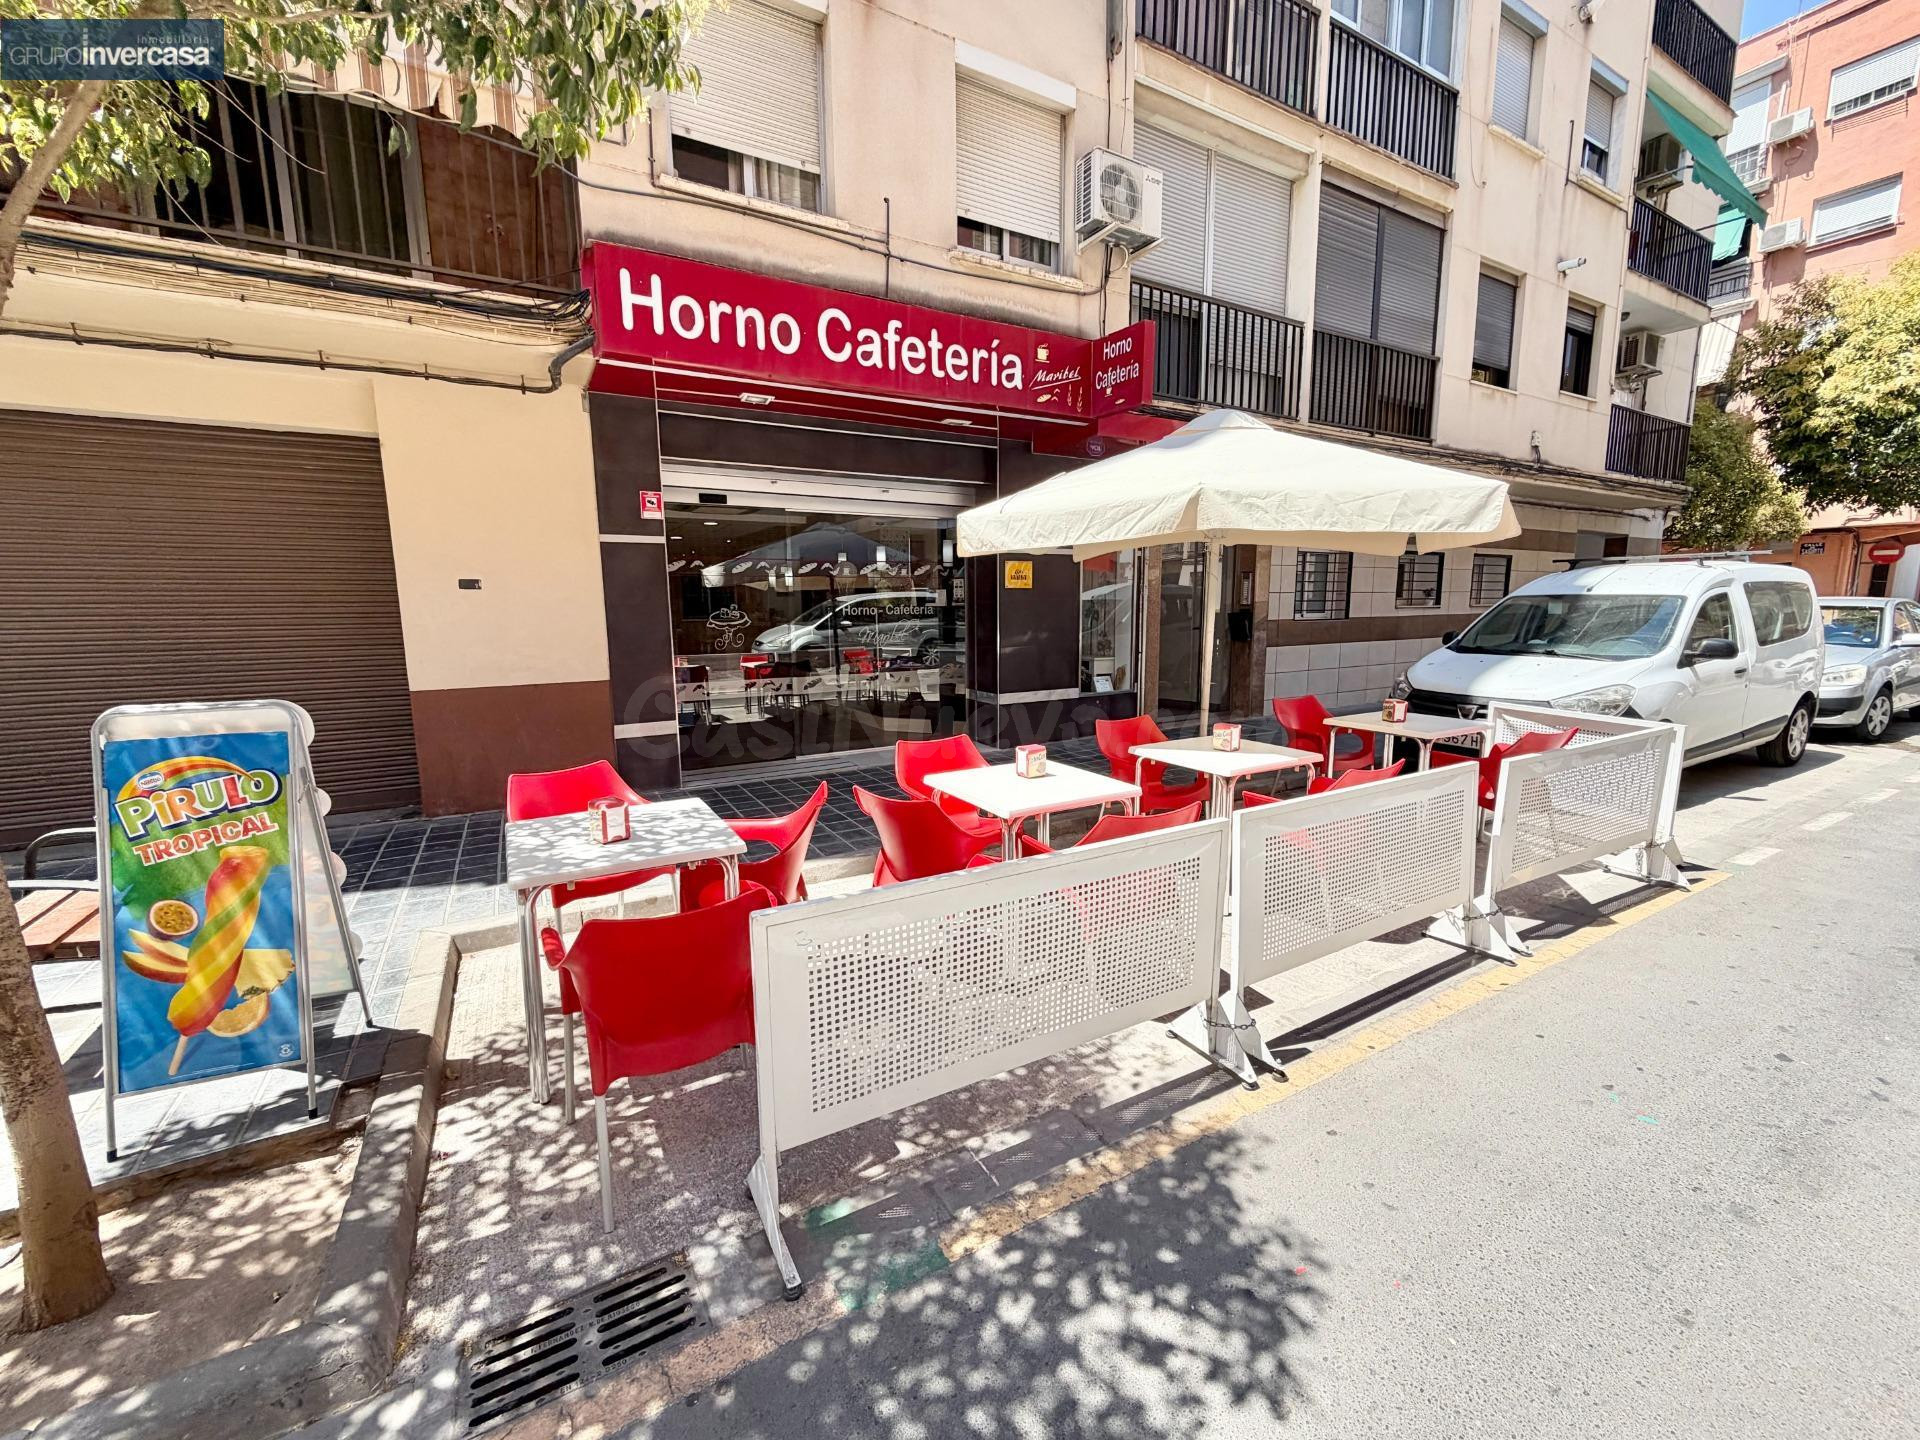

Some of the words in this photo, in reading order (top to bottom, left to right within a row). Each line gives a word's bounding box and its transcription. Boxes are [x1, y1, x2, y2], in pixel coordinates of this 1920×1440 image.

[618, 267, 801, 355] Horno
[817, 308, 1023, 390] Cafetería
[1103, 337, 1133, 361] Horno
[1029, 365, 1081, 388] Maribel
[1095, 360, 1140, 390] Cafetería
[842, 605, 878, 616] Horno
[133, 812, 280, 867] TROPICAL
